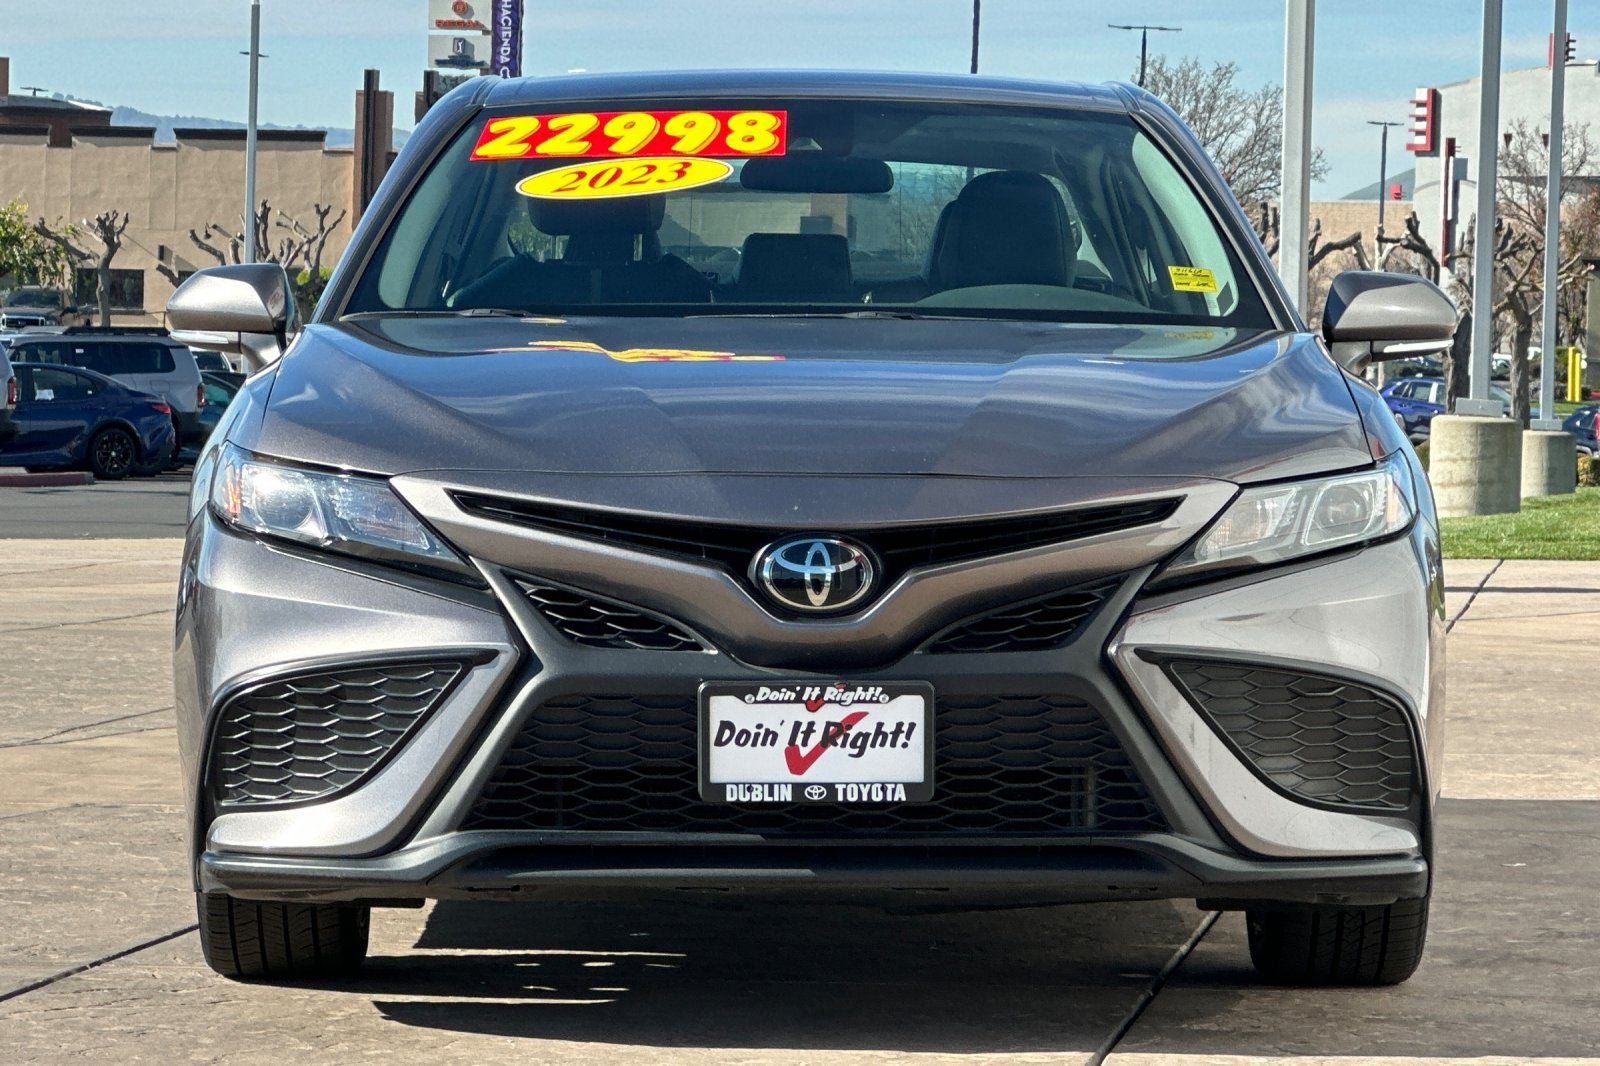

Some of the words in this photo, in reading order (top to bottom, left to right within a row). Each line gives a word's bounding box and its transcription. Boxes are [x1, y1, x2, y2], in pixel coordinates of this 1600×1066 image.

[475, 111, 782, 157] 22998
[551, 161, 692, 193] 2023
[755, 686, 801, 702] Doin'
[802, 686, 821, 701] It
[823, 686, 883, 707] Right!
[713, 720, 784, 748] Doin'
[787, 720, 817, 748] It
[820, 720, 917, 758] Right!
[725, 784, 792, 802] DUBLIN
[835, 784, 906, 802] TOYOTA
